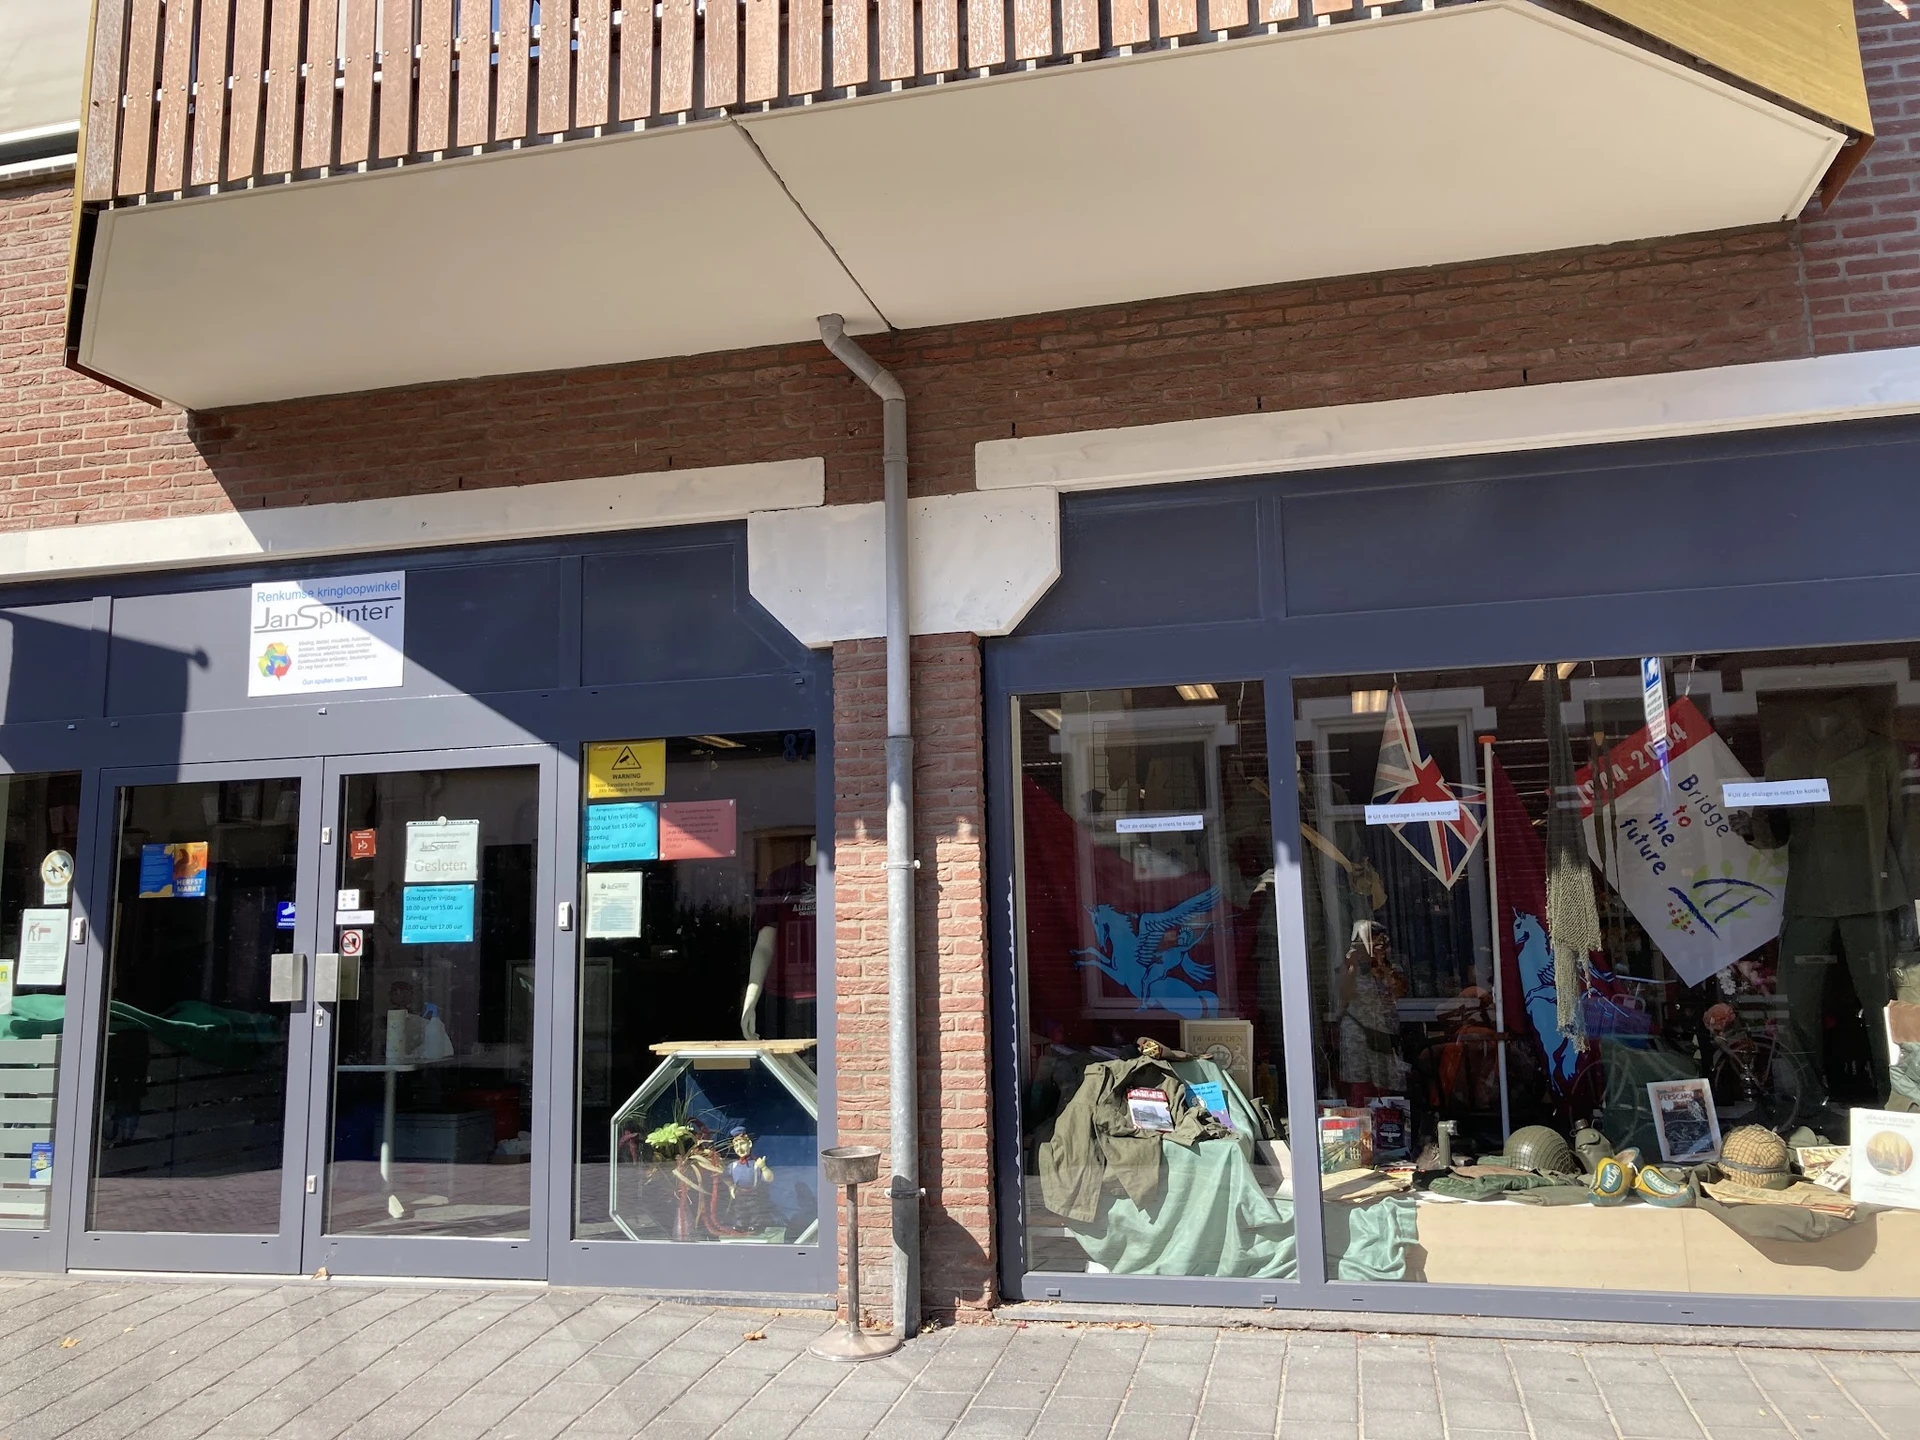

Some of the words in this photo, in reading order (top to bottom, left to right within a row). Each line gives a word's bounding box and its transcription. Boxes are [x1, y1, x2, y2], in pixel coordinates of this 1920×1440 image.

[257, 589, 314, 602] Renkumse
[317, 580, 400, 598] kringloopwinkel
[254, 598, 400, 633] JanSplinter
[784, 732, 812, 762] 87
[1672, 805, 1692, 827] to
[1678, 774, 1728, 837] Bridge
[1648, 812, 1675, 847] the
[1620, 818, 1666, 875] future
[414, 858, 467, 872] Gesloten
[1603, 1166, 1621, 1190] HOLLAND
